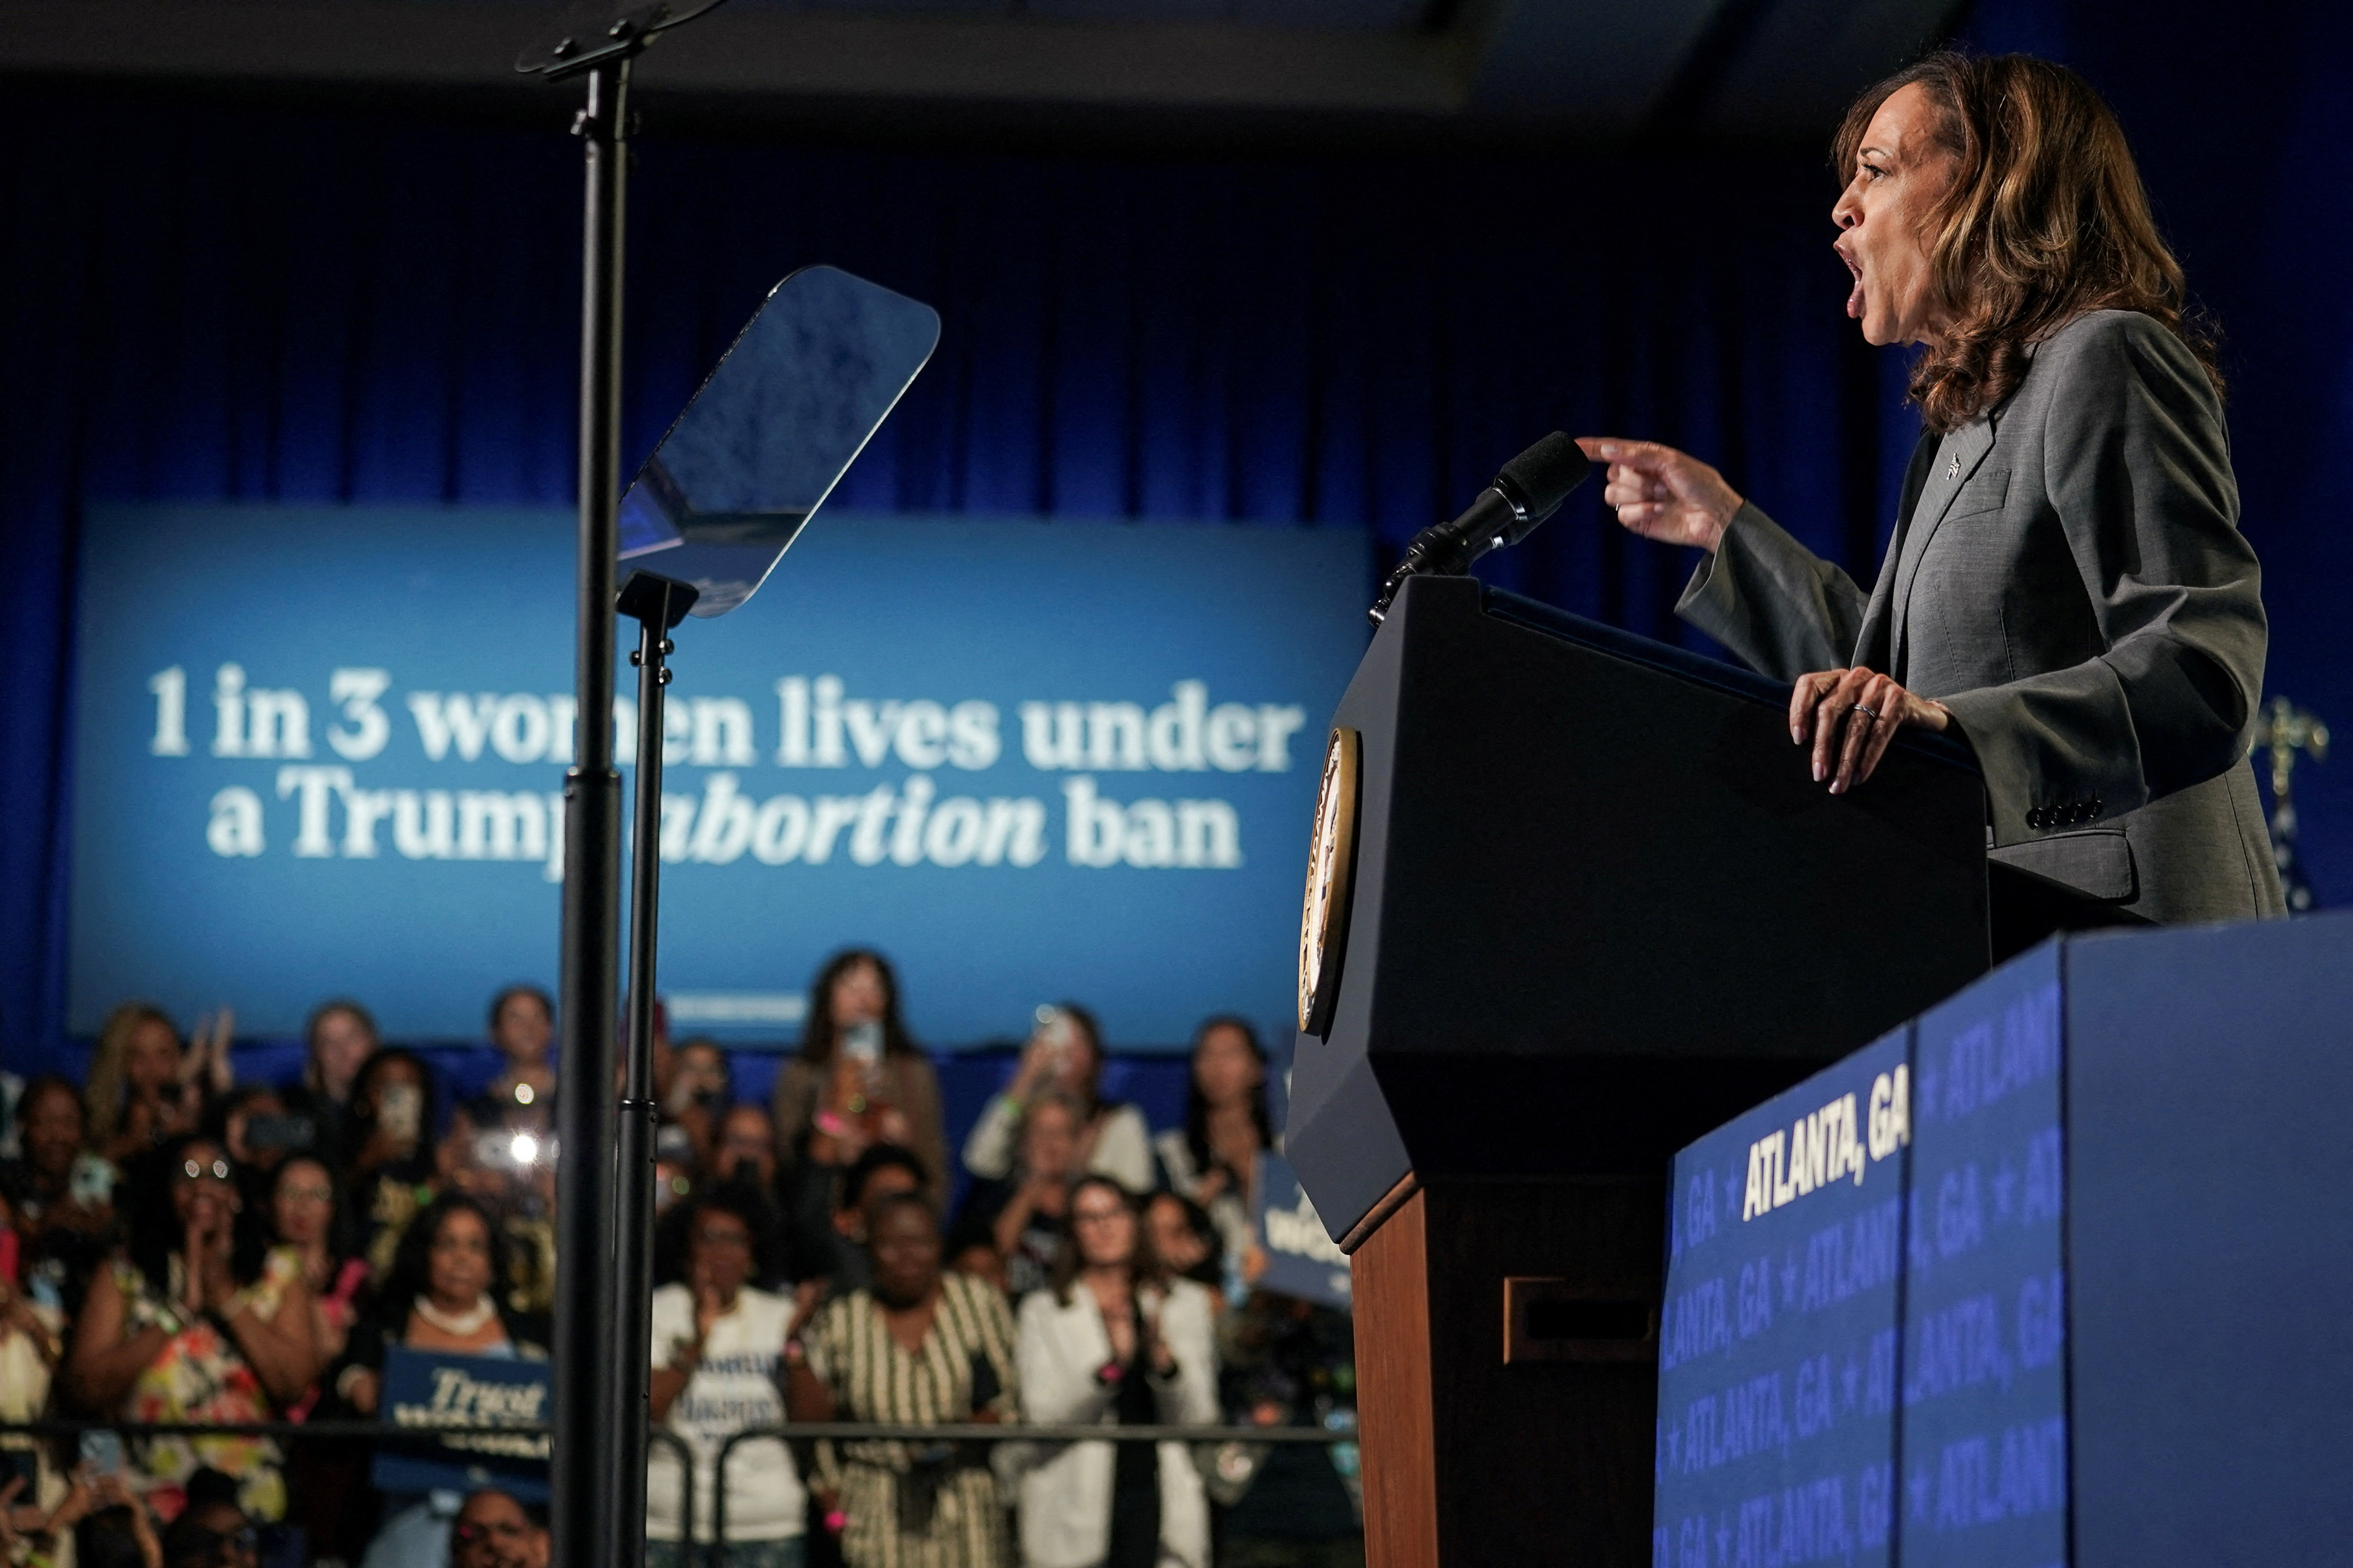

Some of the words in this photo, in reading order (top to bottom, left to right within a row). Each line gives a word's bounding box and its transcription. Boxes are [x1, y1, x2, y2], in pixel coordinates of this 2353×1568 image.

[148, 665, 189, 758] 1
[211, 663, 313, 759] in
[327, 667, 392, 761] 3
[405, 692, 759, 766] women
[774, 674, 1001, 769] lives
[1017, 679, 1305, 772] under
[205, 785, 266, 858] a
[631, 773, 1047, 868] abortion
[1061, 775, 1241, 868] ban
[1743, 1092, 1866, 1222] ATLANTA,
[1868, 1063, 1911, 1162] GA
